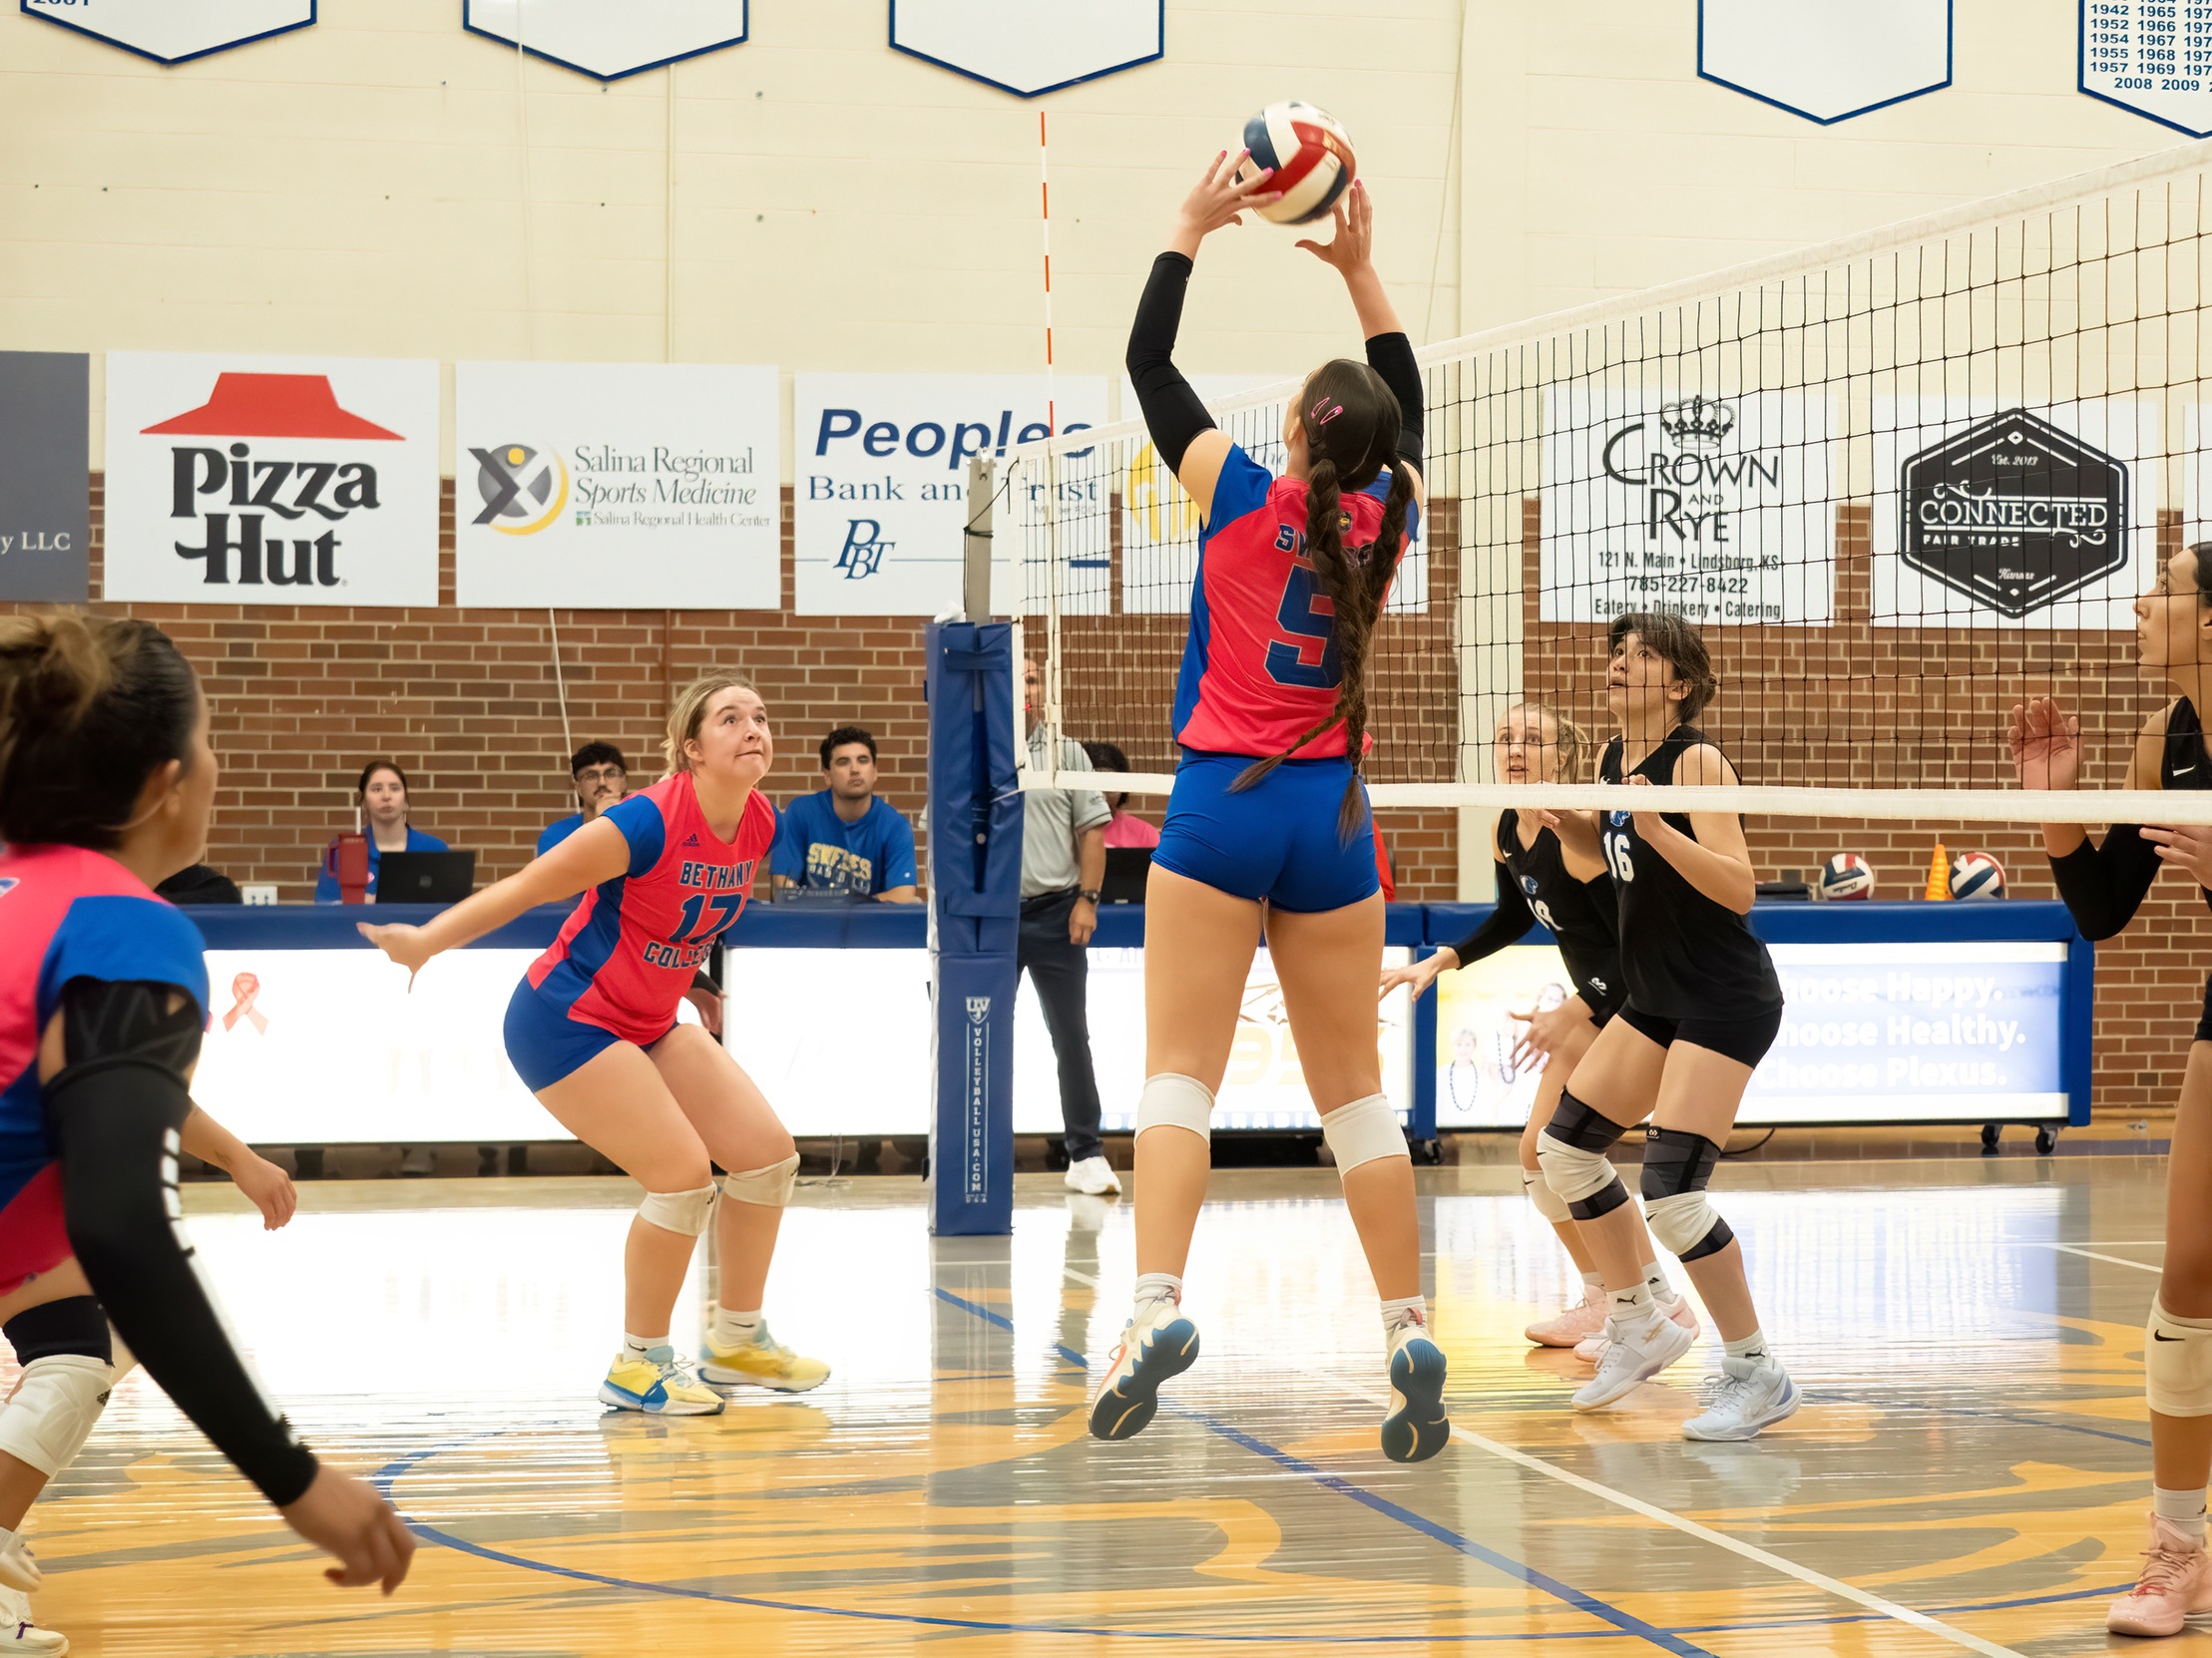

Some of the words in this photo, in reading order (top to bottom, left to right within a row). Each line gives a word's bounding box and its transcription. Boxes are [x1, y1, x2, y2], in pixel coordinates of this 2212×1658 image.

[2090, 4, 2129, 15] 1942
[2137, 5, 2176, 18] 1965
[2090, 18, 2129, 30] 1952
[2137, 20, 2176, 32] 1966
[2090, 33, 2129, 44] 1954
[2137, 34, 2176, 46] 1967
[2090, 47, 2129, 58] 1955
[2137, 48, 2176, 61] 1968
[2090, 61, 2129, 73] 1957
[2137, 62, 2176, 75] 1969
[2114, 77, 2153, 90] 2008
[2161, 79, 2200, 92] 2009
[574, 444, 647, 474] Salina
[654, 446, 753, 482] Regional
[170, 442, 381, 521] Pizza
[574, 478, 647, 510] Sports
[653, 478, 757, 506] Medicine
[808, 475, 905, 501] Bank
[921, 480, 970, 502] an
[594, 511, 631, 526] Salina
[634, 511, 684, 528] Regional
[687, 512, 728, 526] Health
[730, 512, 771, 527] Center
[1920, 498, 2108, 530] CONNECTED
[21, 532, 71, 552] LLC
[175, 513, 342, 587] Hut
[1598, 552, 1619, 568] 121
[1625, 552, 1638, 568] N.
[1645, 553, 1674, 568] Main
[1691, 553, 1758, 573] Lindsborg,
[1762, 555, 1779, 571] KS
[1629, 576, 1749, 594] 785-227-8422
[1725, 601, 1781, 621] Catering
[1263, 564, 1343, 690] 5
[1603, 831, 1634, 882] 16
[678, 859, 754, 890] BETHANY
[666, 892, 743, 945] 17
[1777, 971, 1879, 1004] hoose
[1886, 971, 2003, 1009] Happy.
[1776, 1015, 1879, 1047] hoose
[1886, 1013, 2026, 1051] Healthy.
[1755, 1056, 1879, 1089] Choose
[1886, 1054, 2007, 1088] Plexus.
